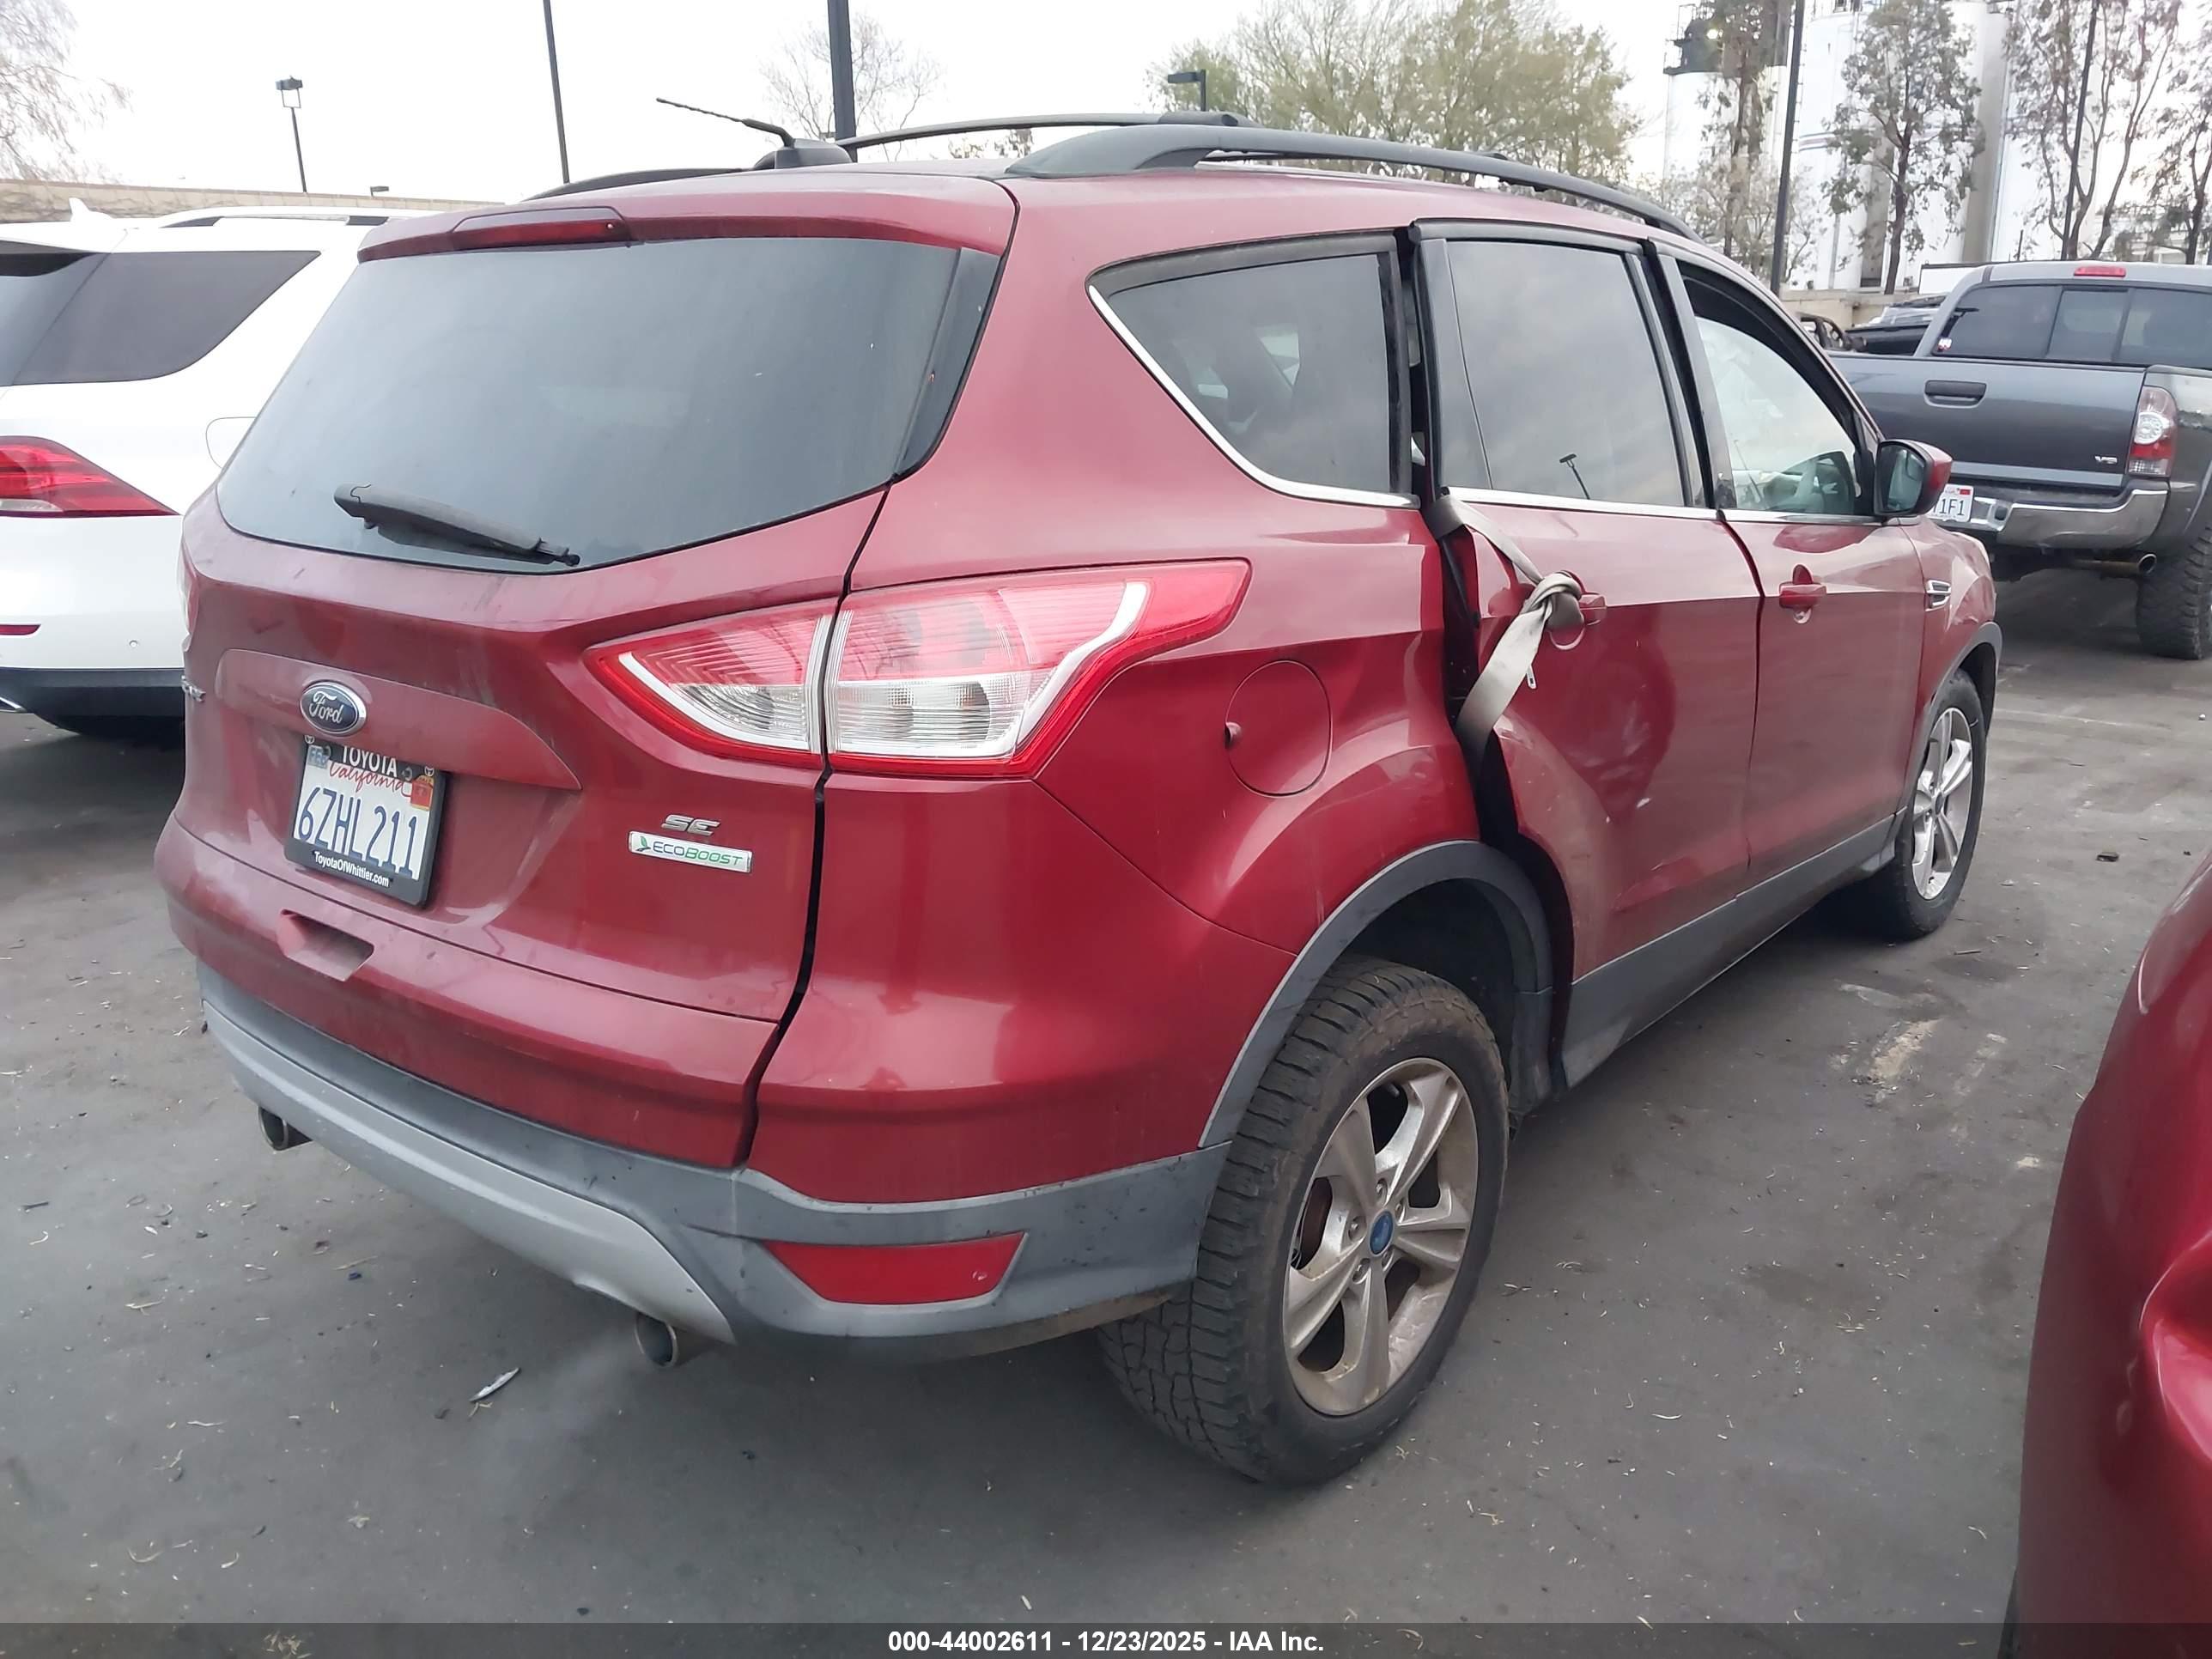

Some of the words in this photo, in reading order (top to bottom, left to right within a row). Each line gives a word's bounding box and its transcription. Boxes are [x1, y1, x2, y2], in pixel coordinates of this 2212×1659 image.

[309, 691, 344, 723] Ford
[343, 745, 398, 778] TOYOTA
[298, 787, 414, 875] 6ZHL211
[661, 814, 720, 836] SE
[314, 851, 390, 888] ToyotaOfWhittier.com
[653, 841, 743, 866] ECOBOOST
